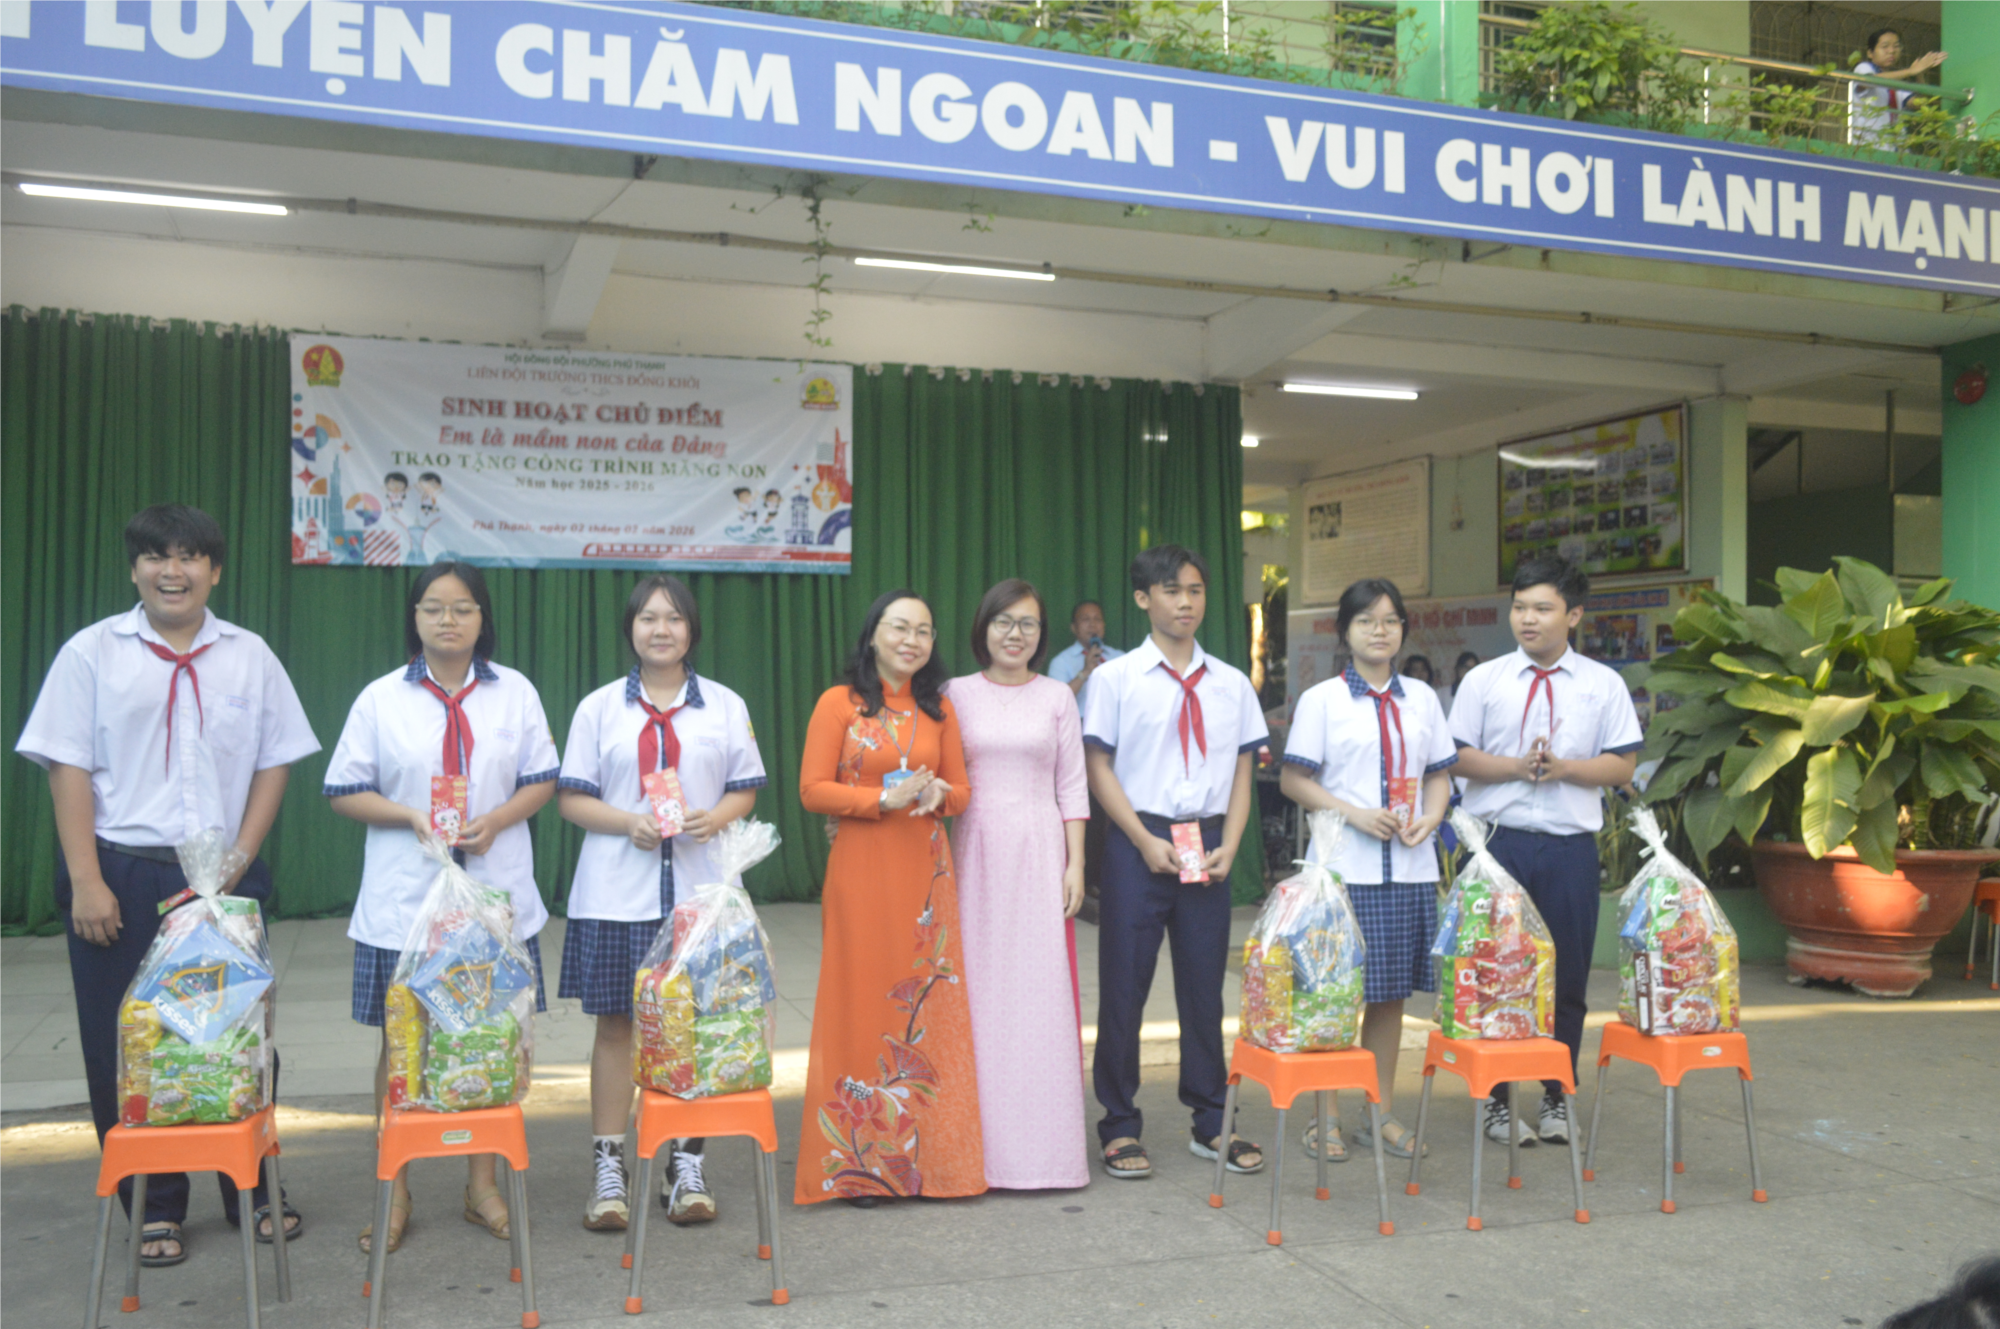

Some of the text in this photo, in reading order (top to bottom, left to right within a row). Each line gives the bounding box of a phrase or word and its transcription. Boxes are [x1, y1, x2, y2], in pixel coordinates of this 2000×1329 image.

[495, 23, 799, 126] CHĂM
[834, 61, 1174, 168] NGOAN
[1208, 139, 1238, 162] -
[1264, 115, 1405, 194] VUI
[1434, 138, 1615, 218] CHƠI
[1642, 157, 1821, 242] LÀNH
[467, 365, 499, 379] LIÊN
[501, 367, 527, 381] ĐỘI
[530, 369, 587, 384] TRƯỜNG
[590, 373, 624, 387] THCS
[441, 396, 724, 428] SINH HOẠT CHỦ ĐIỂM
[439, 425, 727, 459] Em là mầm non của Đảng
[391, 451, 767, 478] TRAO TẶNG CÔNG TRÌNH MĂNG NON
[515, 476, 546, 489] Năm
[551, 478, 574, 491] học
[579, 479, 610, 490] 2025
[624, 480, 655, 492] 2026
[539, 523, 567, 535] ngày
[588, 523, 621, 535] tháng
[642, 525, 666, 535] năm
[669, 525, 696, 536] 2026
